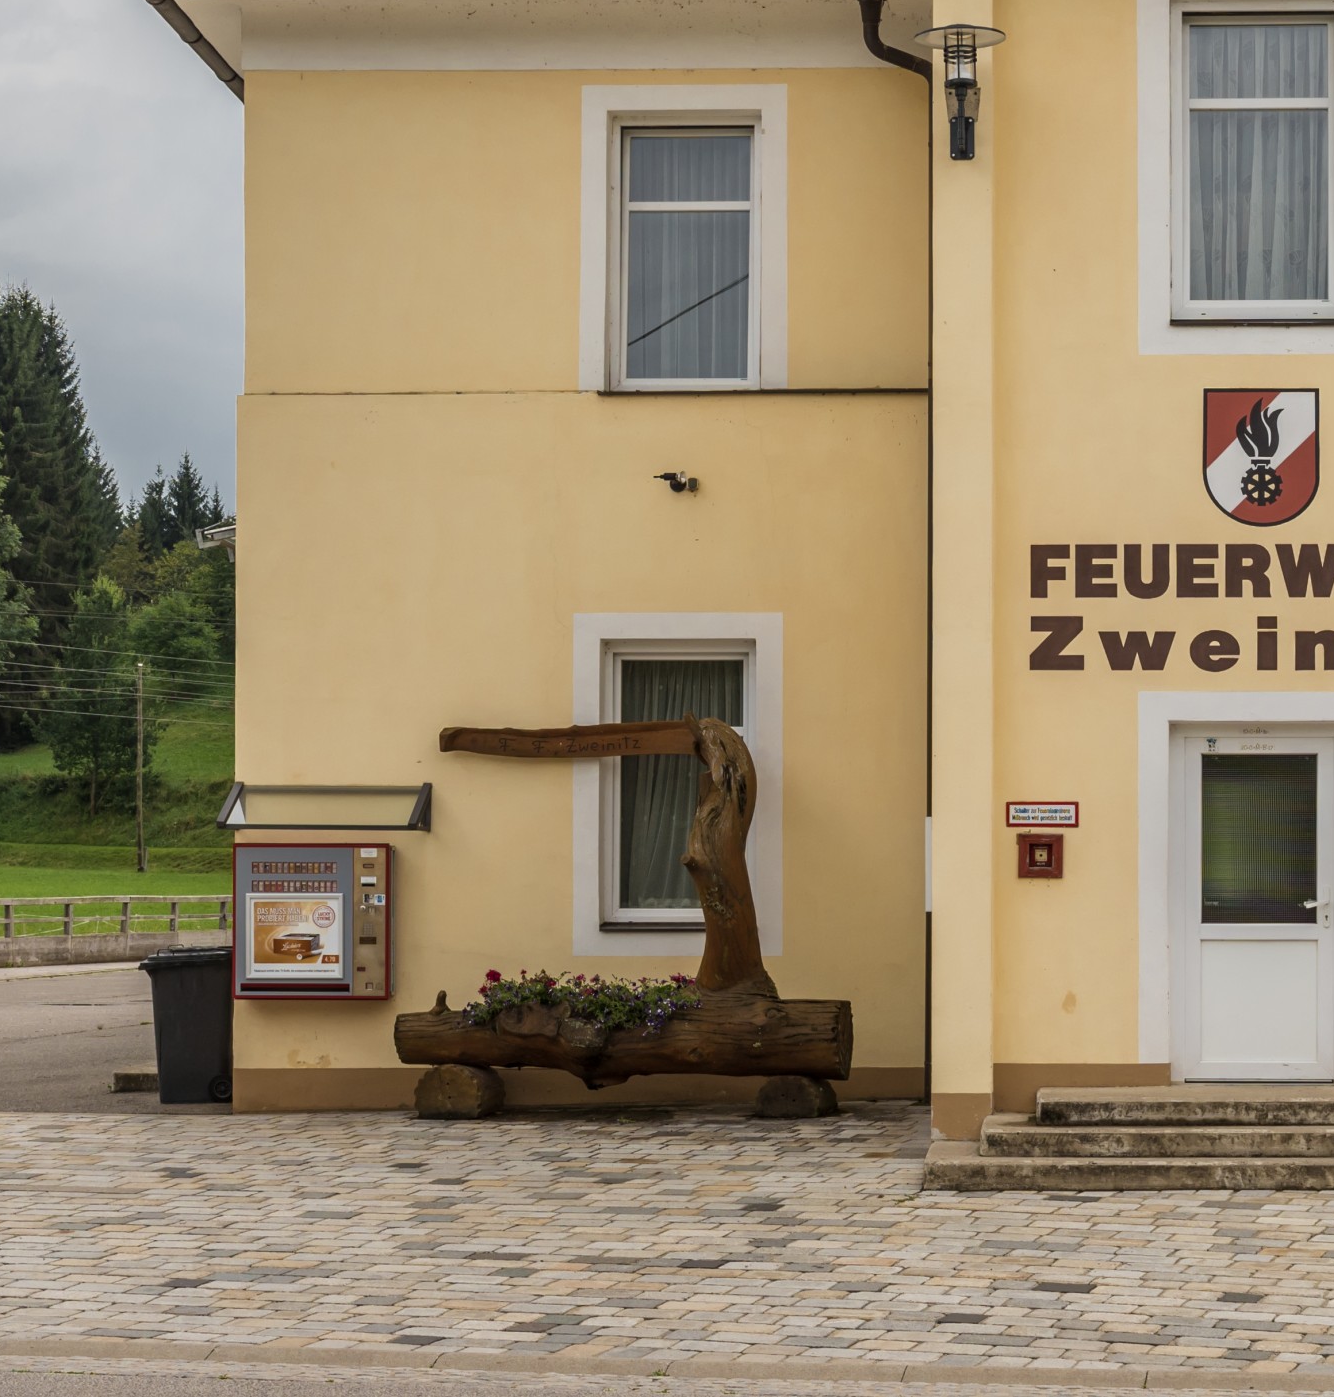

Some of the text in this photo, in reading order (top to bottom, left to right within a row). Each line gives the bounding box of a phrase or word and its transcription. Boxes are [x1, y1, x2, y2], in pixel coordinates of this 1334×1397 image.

[257, 907, 301, 915] DAS MUSS MAN
